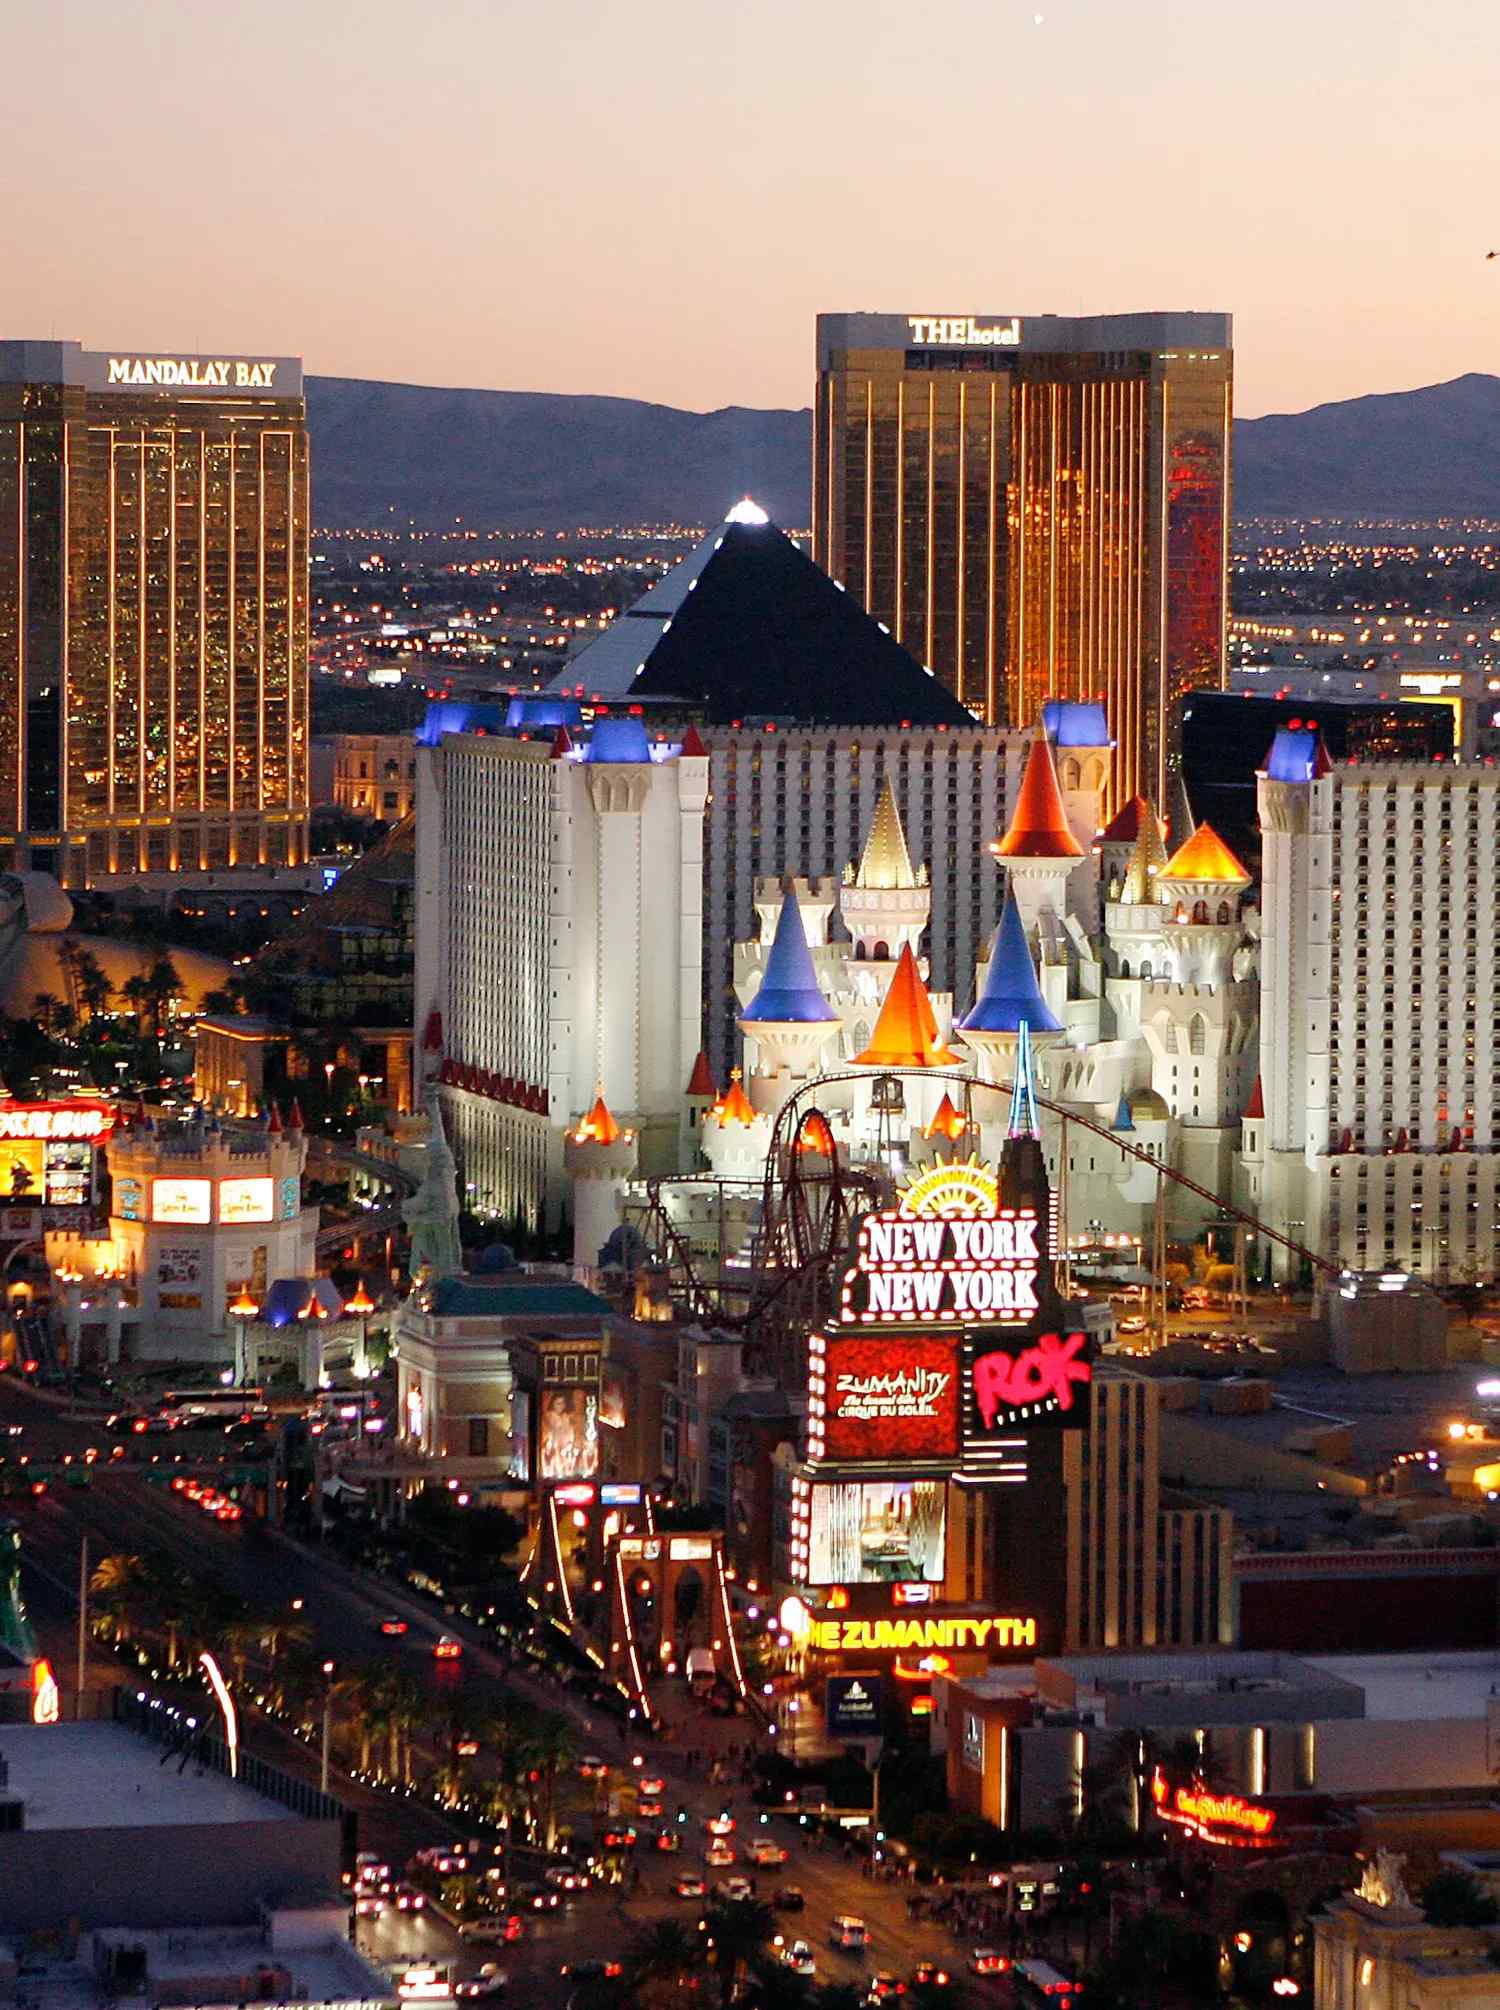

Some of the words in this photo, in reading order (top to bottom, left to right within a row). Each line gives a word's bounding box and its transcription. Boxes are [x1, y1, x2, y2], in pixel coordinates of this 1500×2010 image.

[107, 359, 230, 386] MANDALAY
[235, 361, 276, 387] BAY
[868, 1221, 946, 1261] NEW
[950, 1219, 1040, 1261] YORK
[868, 1270, 946, 1312] NEW
[950, 1269, 1040, 1311] YORK
[836, 1366, 950, 1401] ZUMANITY
[838, 1405, 878, 1419] CIRQUE
[880, 1405, 897, 1416] DU
[841, 1618, 993, 1649] ZUMANITY
